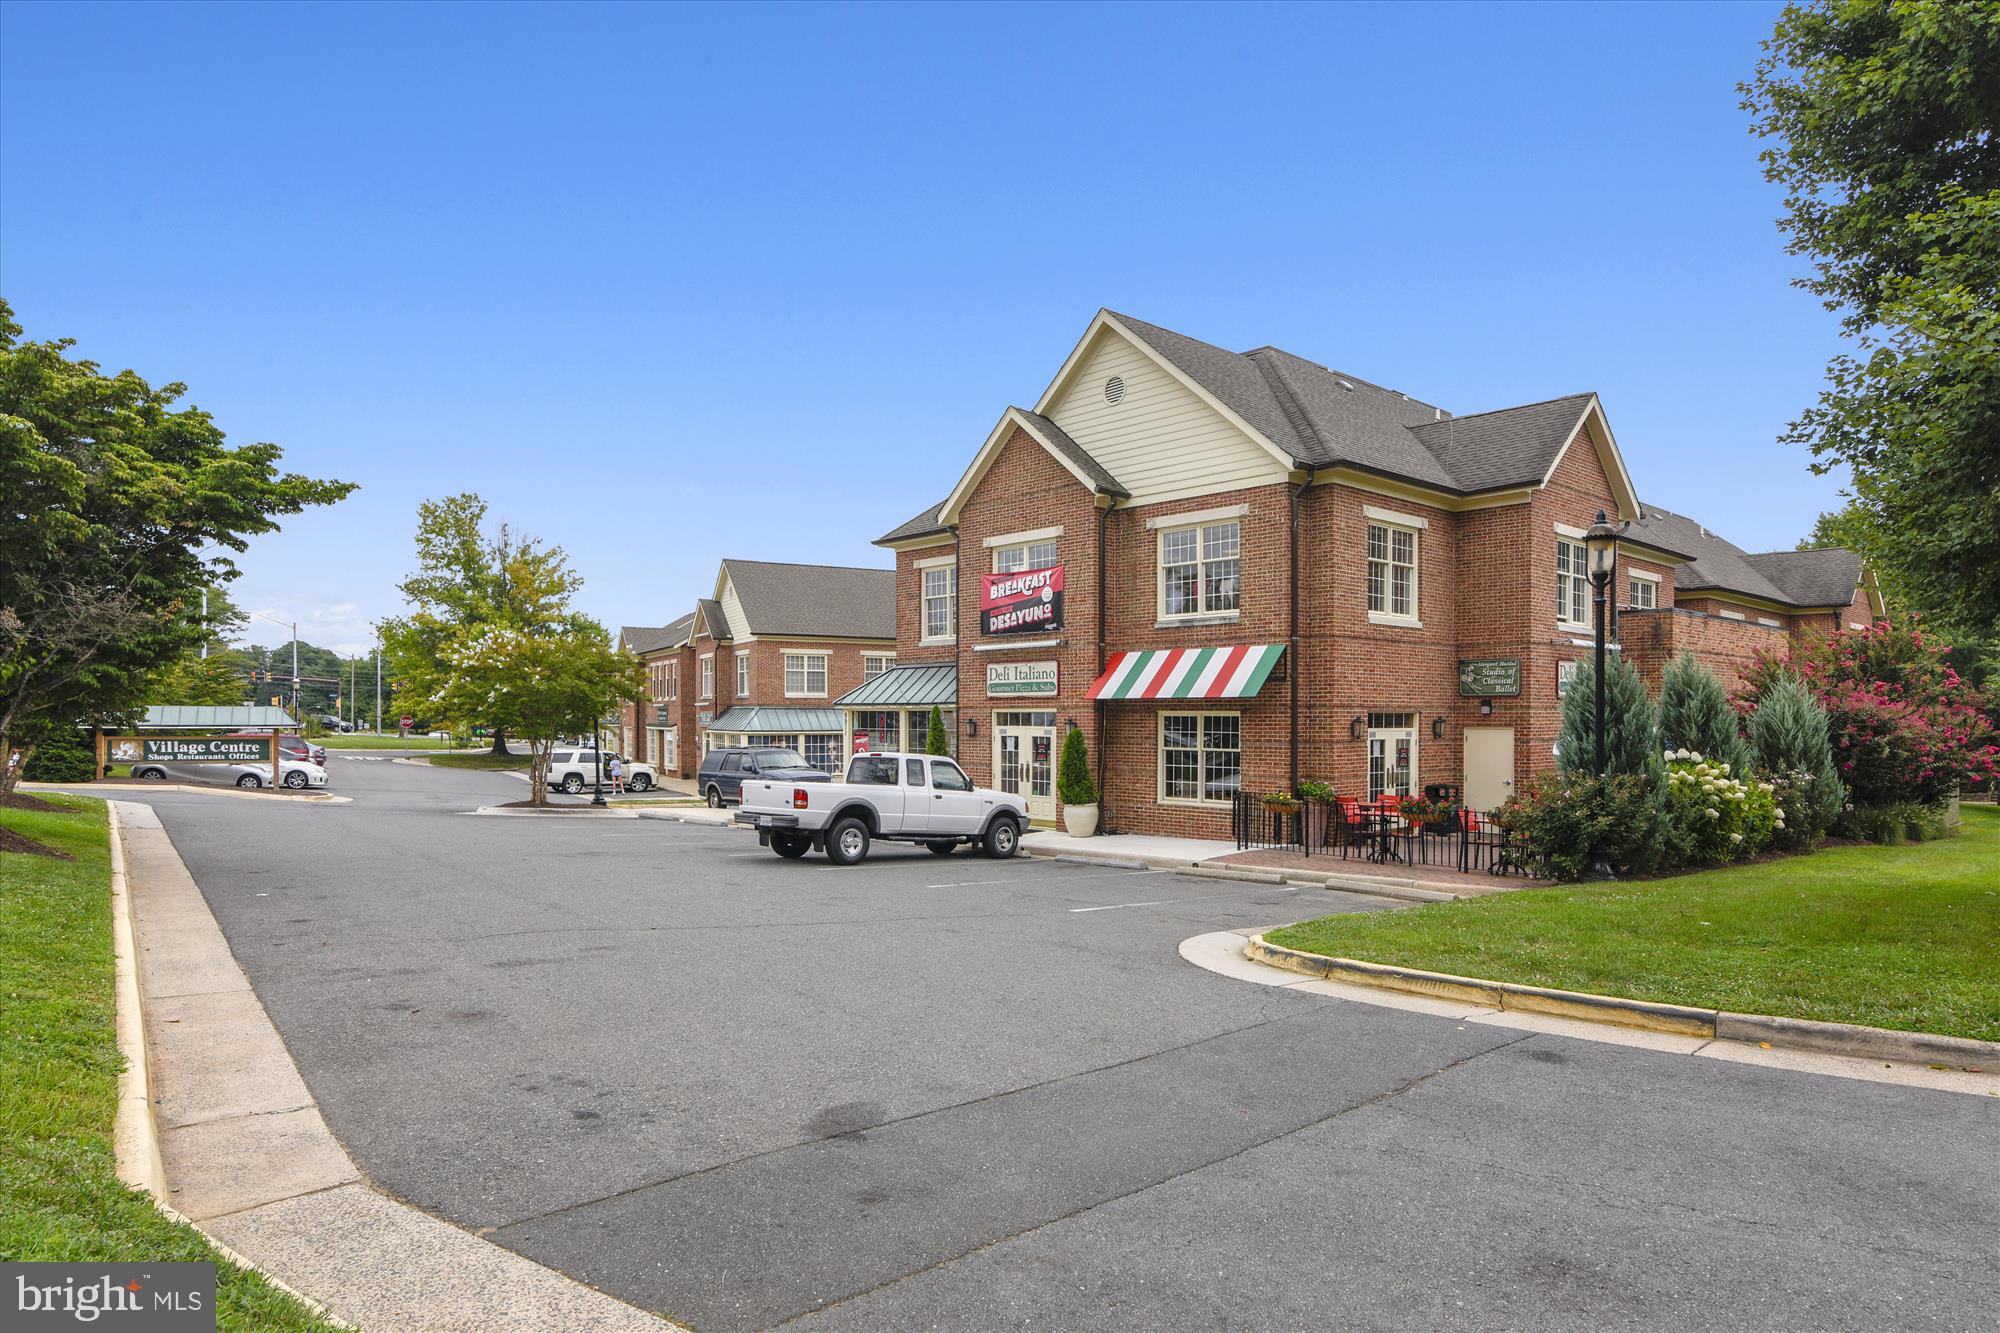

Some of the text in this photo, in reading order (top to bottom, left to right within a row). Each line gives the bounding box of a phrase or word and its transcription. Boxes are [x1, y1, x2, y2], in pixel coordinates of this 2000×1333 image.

[990, 570, 1052, 600] BREAKFAST
[990, 603, 1053, 631] DESAYUNO
[989, 666, 1056, 681] Deli Italiano
[1482, 667, 1516, 677] Studio of
[1482, 677, 1515, 685] Classical
[1015, 684, 1031, 692] Pizza
[1495, 685, 1517, 693] Ballet
[148, 741, 260, 754] Village Centre
[148, 753, 174, 761] Shops
